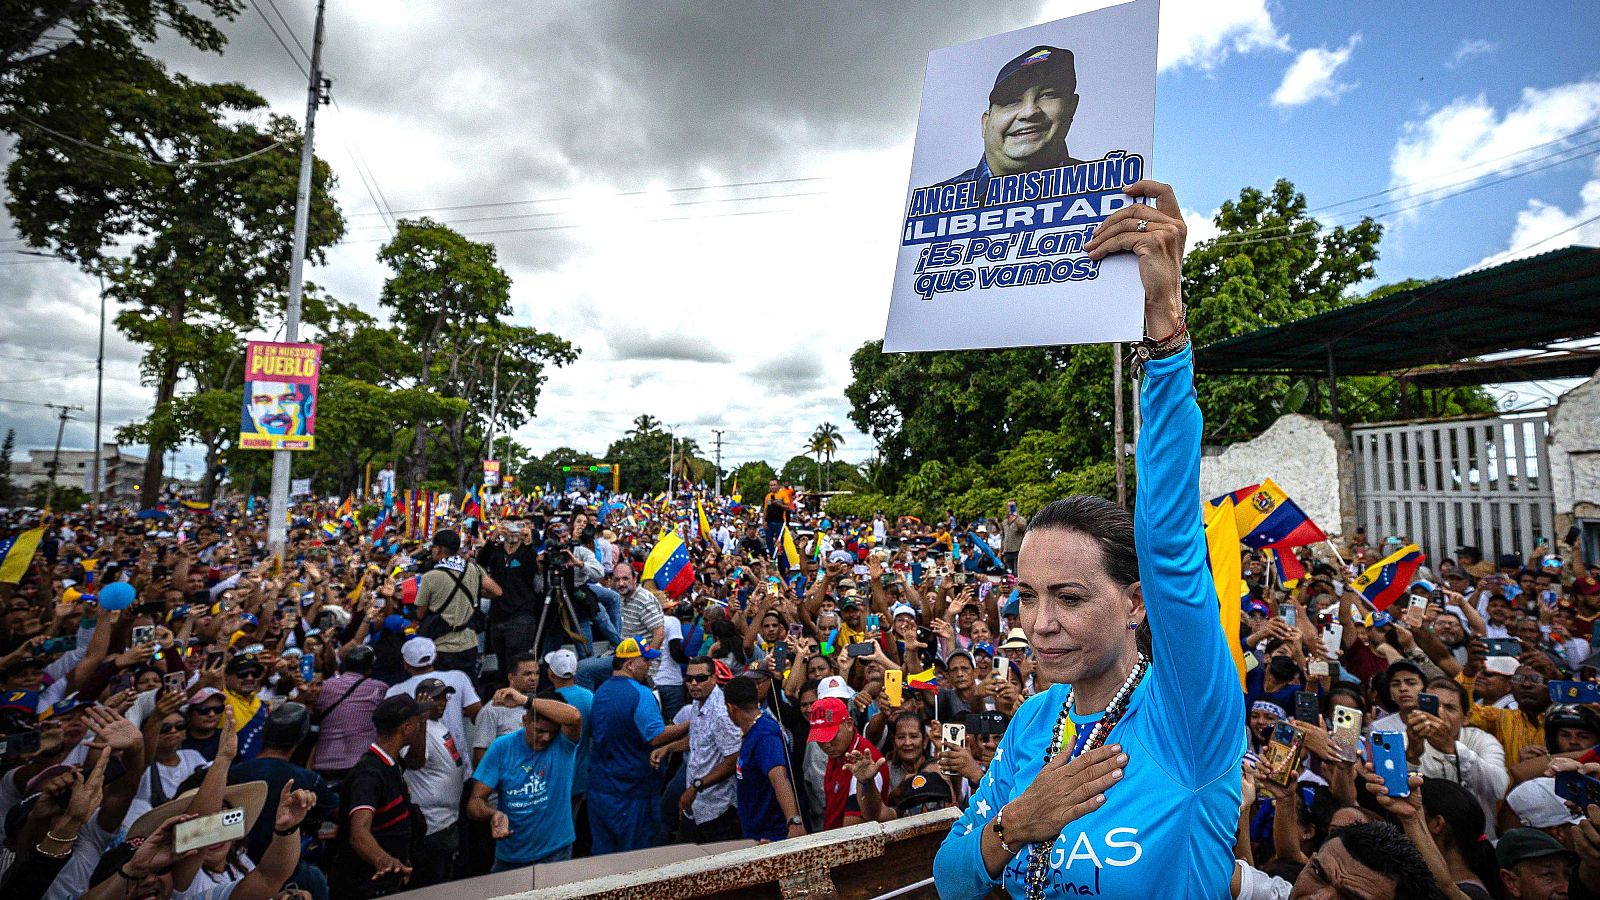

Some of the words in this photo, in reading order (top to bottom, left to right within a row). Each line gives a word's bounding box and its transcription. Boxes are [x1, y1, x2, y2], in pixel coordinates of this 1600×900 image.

[909, 181, 979, 217] ANGEL
[985, 150, 1143, 207] ARISTIMUÑO
[914, 241, 963, 274] ¡Es
[965, 232, 1018, 264] Pa'
[914, 269, 976, 300] que
[979, 258, 1103, 289] vamos!
[251, 355, 315, 377] PUEBLO
[1053, 865, 1101, 896] final
